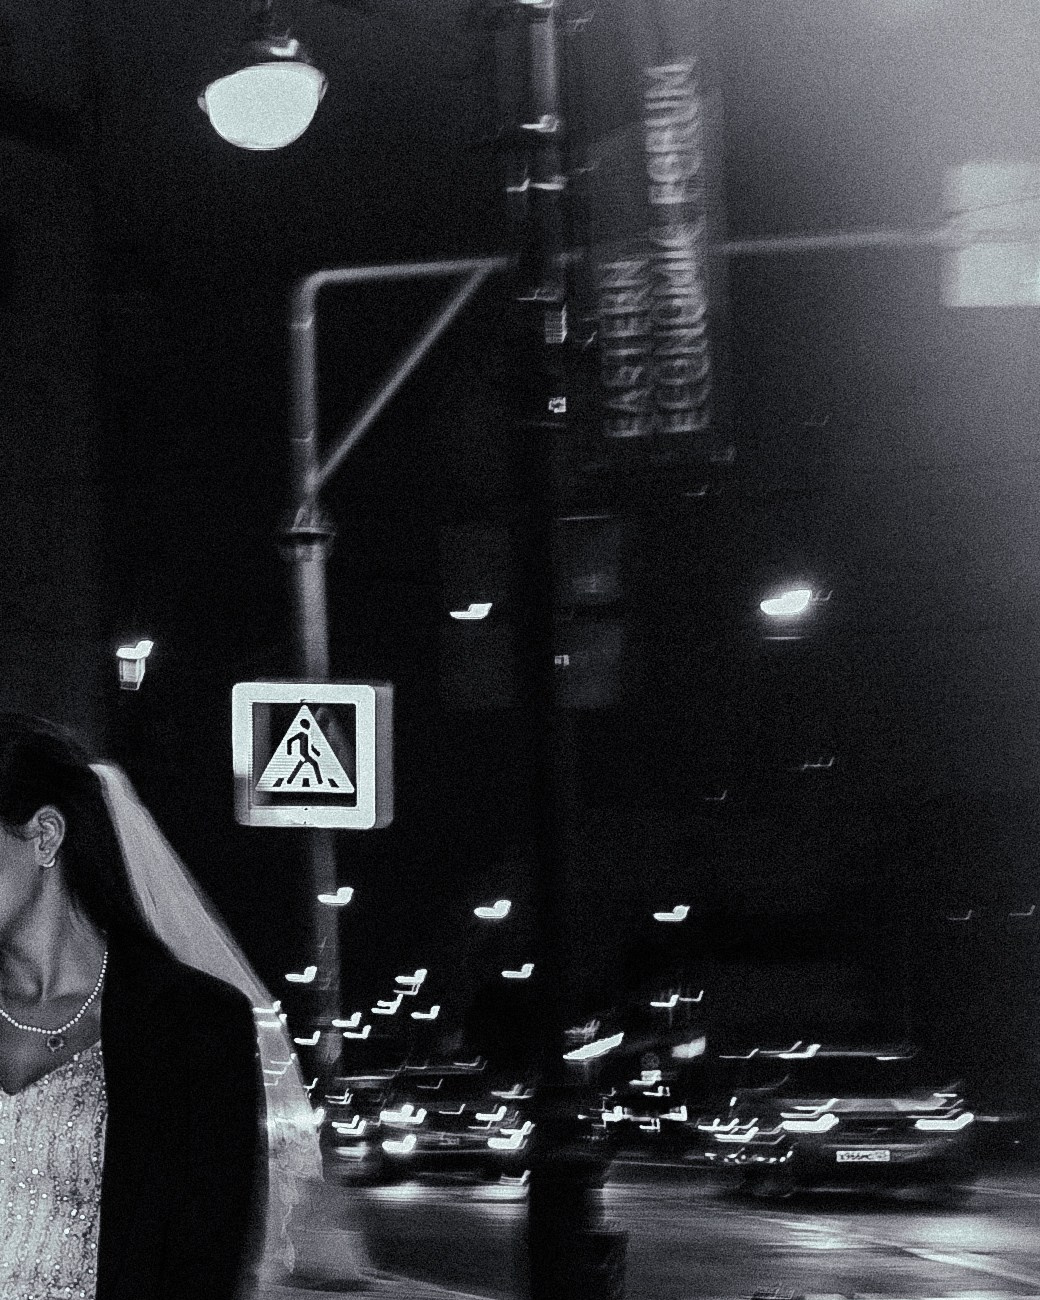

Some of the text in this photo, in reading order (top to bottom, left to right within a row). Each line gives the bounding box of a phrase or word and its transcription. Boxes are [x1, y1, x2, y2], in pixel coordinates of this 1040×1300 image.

[599, 259, 650, 438] EASTERN
[642, 57, 710, 433] ECONOMIC FORUM
